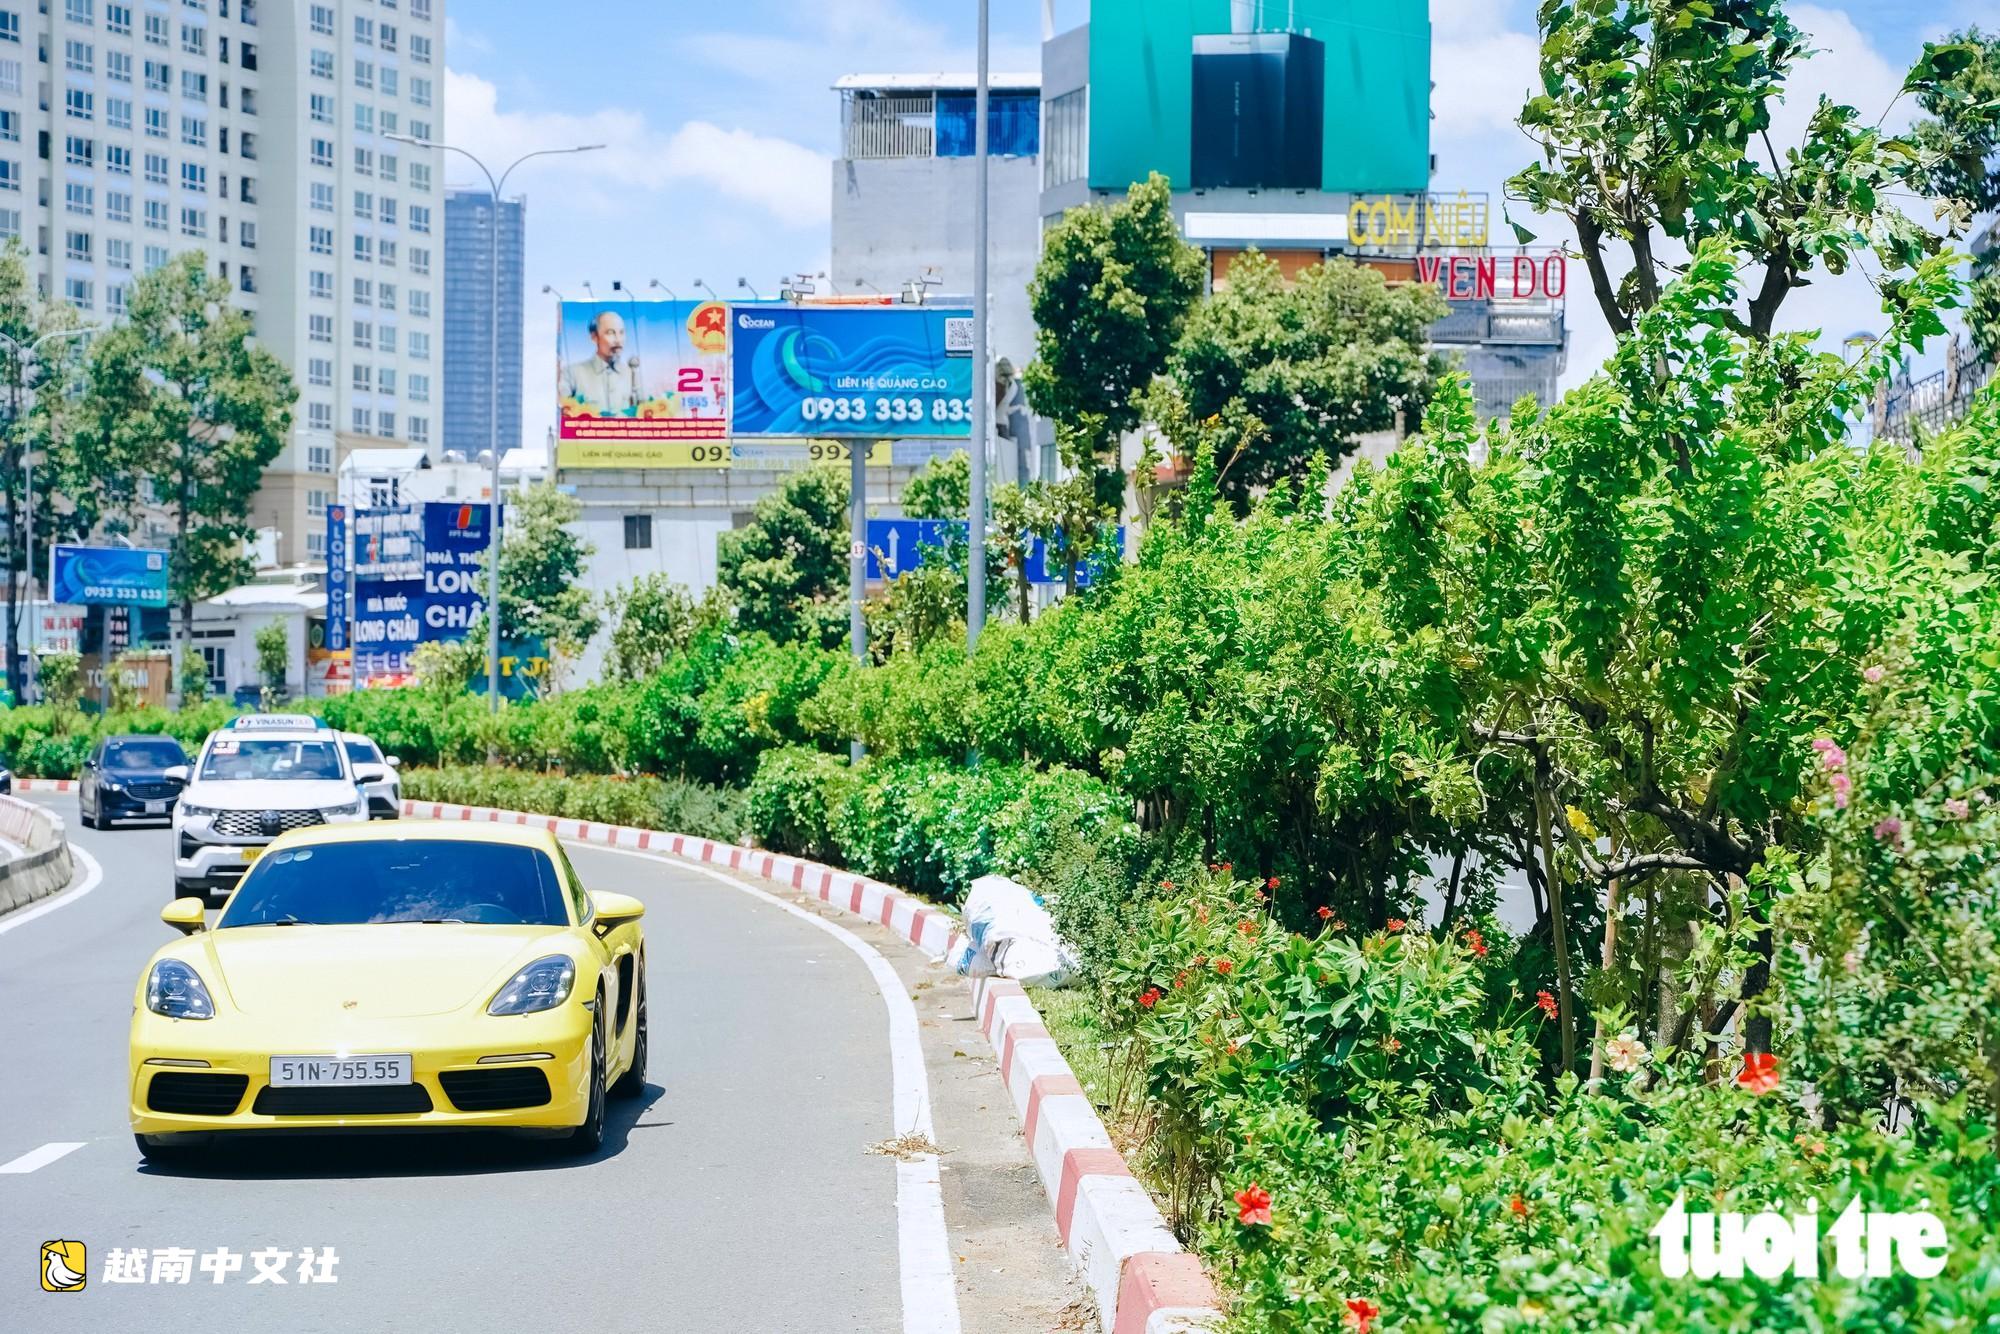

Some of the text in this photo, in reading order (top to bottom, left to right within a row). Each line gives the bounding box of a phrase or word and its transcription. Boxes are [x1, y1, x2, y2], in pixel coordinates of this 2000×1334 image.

[1418, 256, 1497, 299] VEN
[837, 376, 859, 388] LIÊN
[878, 375, 919, 389] QUẢNG
[802, 397, 866, 421] 0933
[876, 398, 923, 421] 333
[331, 525, 345, 583] LONG
[426, 549, 454, 565] NHÀ
[356, 614, 419, 642] LONG CHÂU
[282, 1061, 400, 1081] 51N-755.55
